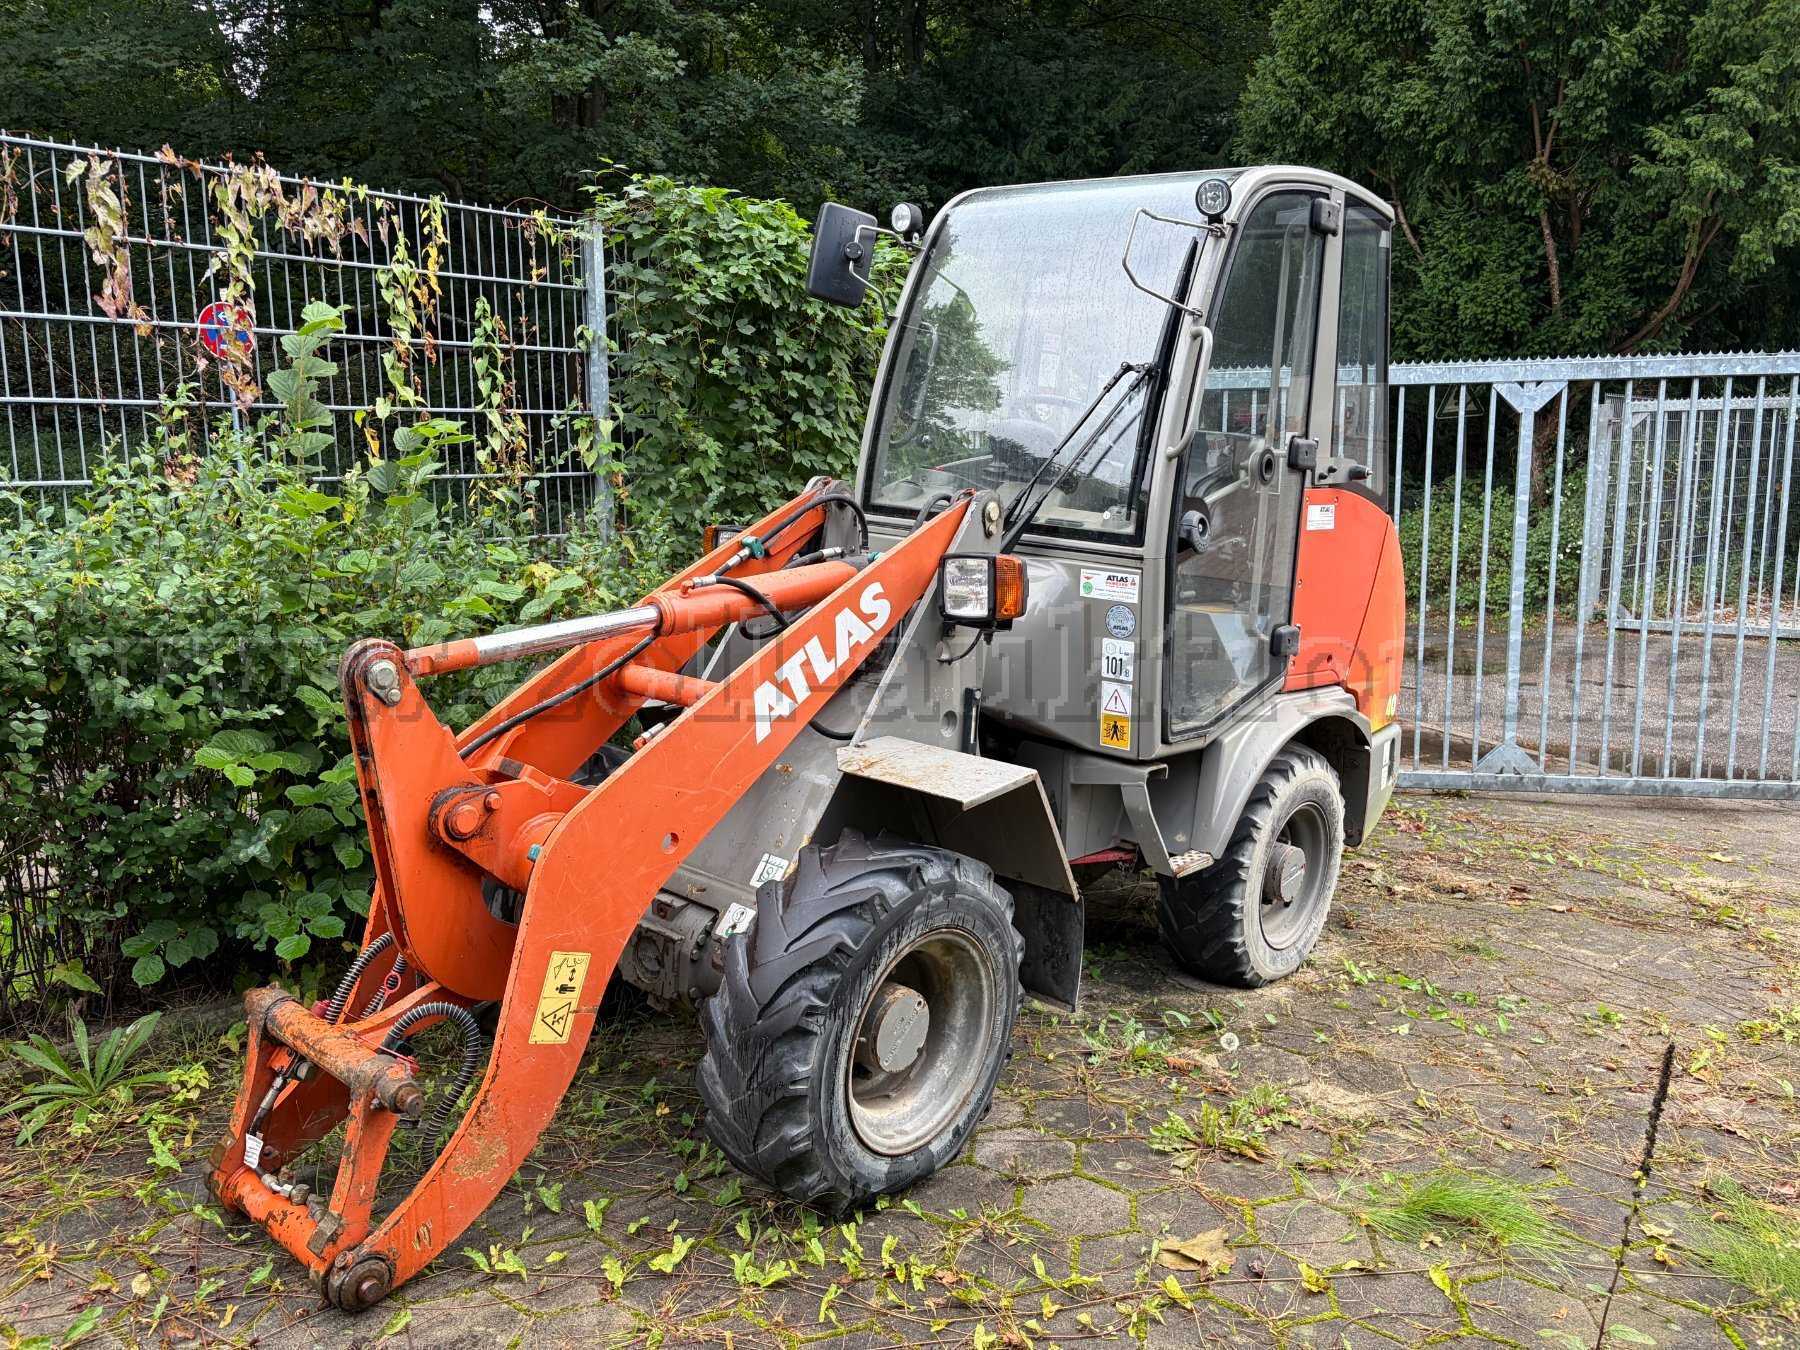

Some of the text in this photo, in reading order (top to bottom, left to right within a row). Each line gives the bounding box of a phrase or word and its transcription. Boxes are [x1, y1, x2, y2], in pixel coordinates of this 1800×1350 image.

[1106, 575, 1129, 583] ATLAS
[753, 581, 892, 745] ATLAS
[1105, 655, 1123, 677] 101
